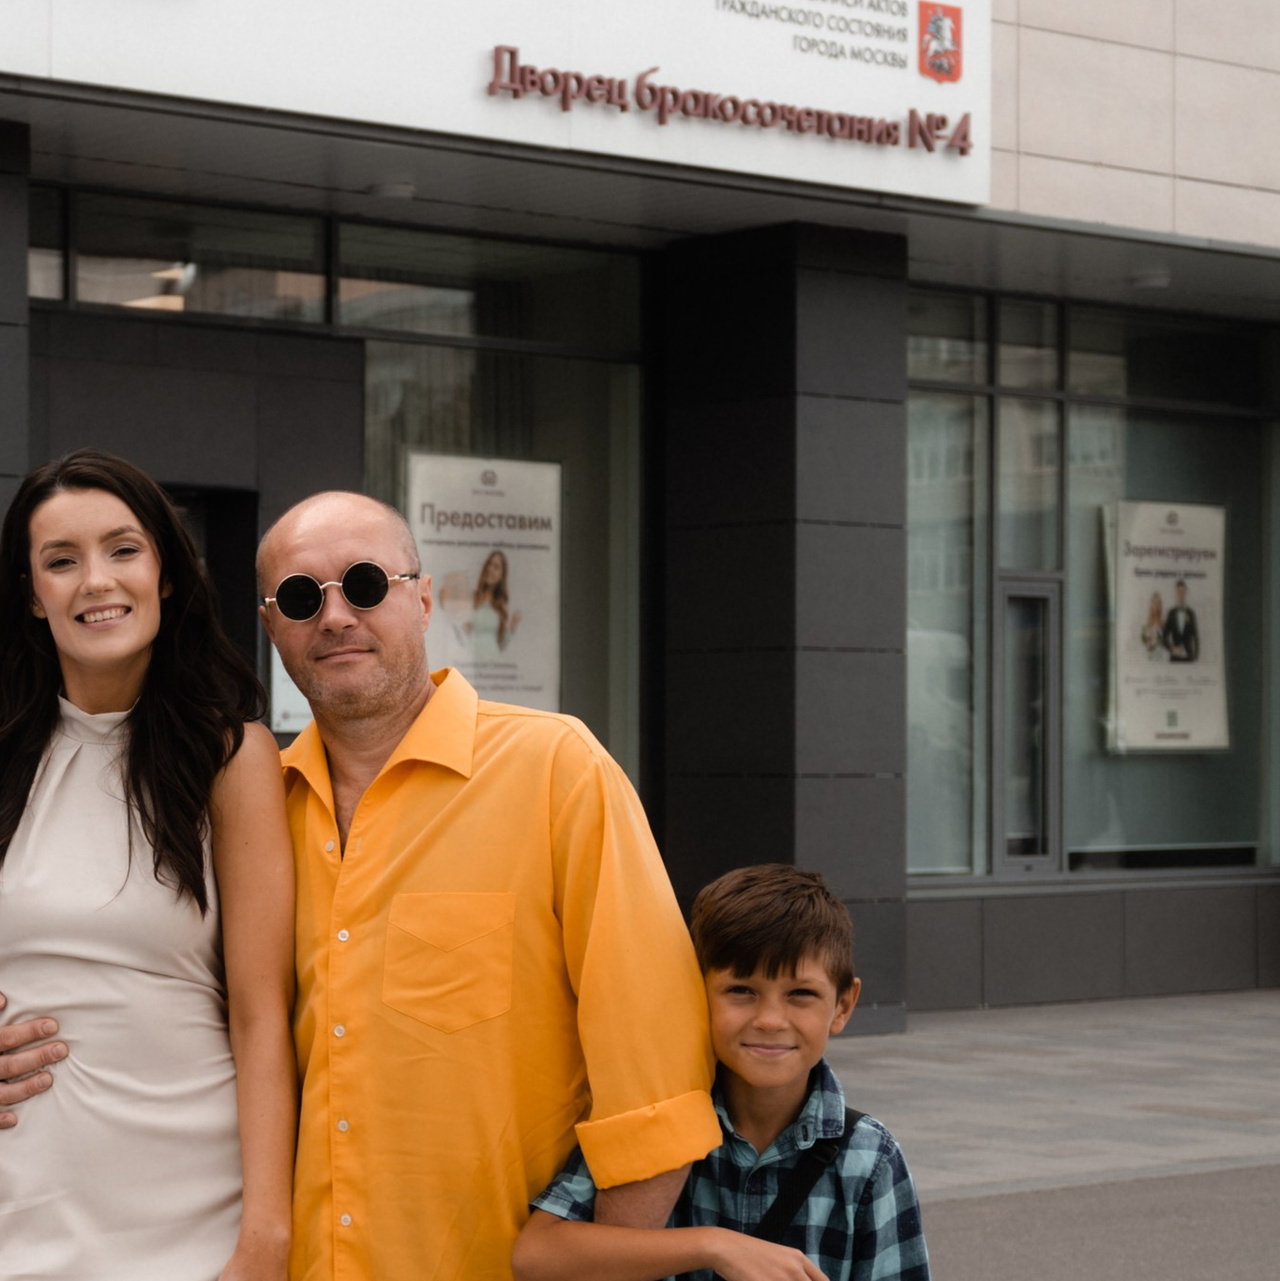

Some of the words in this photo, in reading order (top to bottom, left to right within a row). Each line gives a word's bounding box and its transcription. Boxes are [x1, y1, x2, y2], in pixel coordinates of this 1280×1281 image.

[827, 15, 908, 43] СОСТОЯНИЯ
[792, 34, 847, 60] ГОРОДА
[850, 47, 908, 70] МОСКВЫ
[487, 45, 630, 112] Дворец
[635, 67, 900, 146] бракосочетания
[421, 503, 552, 532] Предоставим
